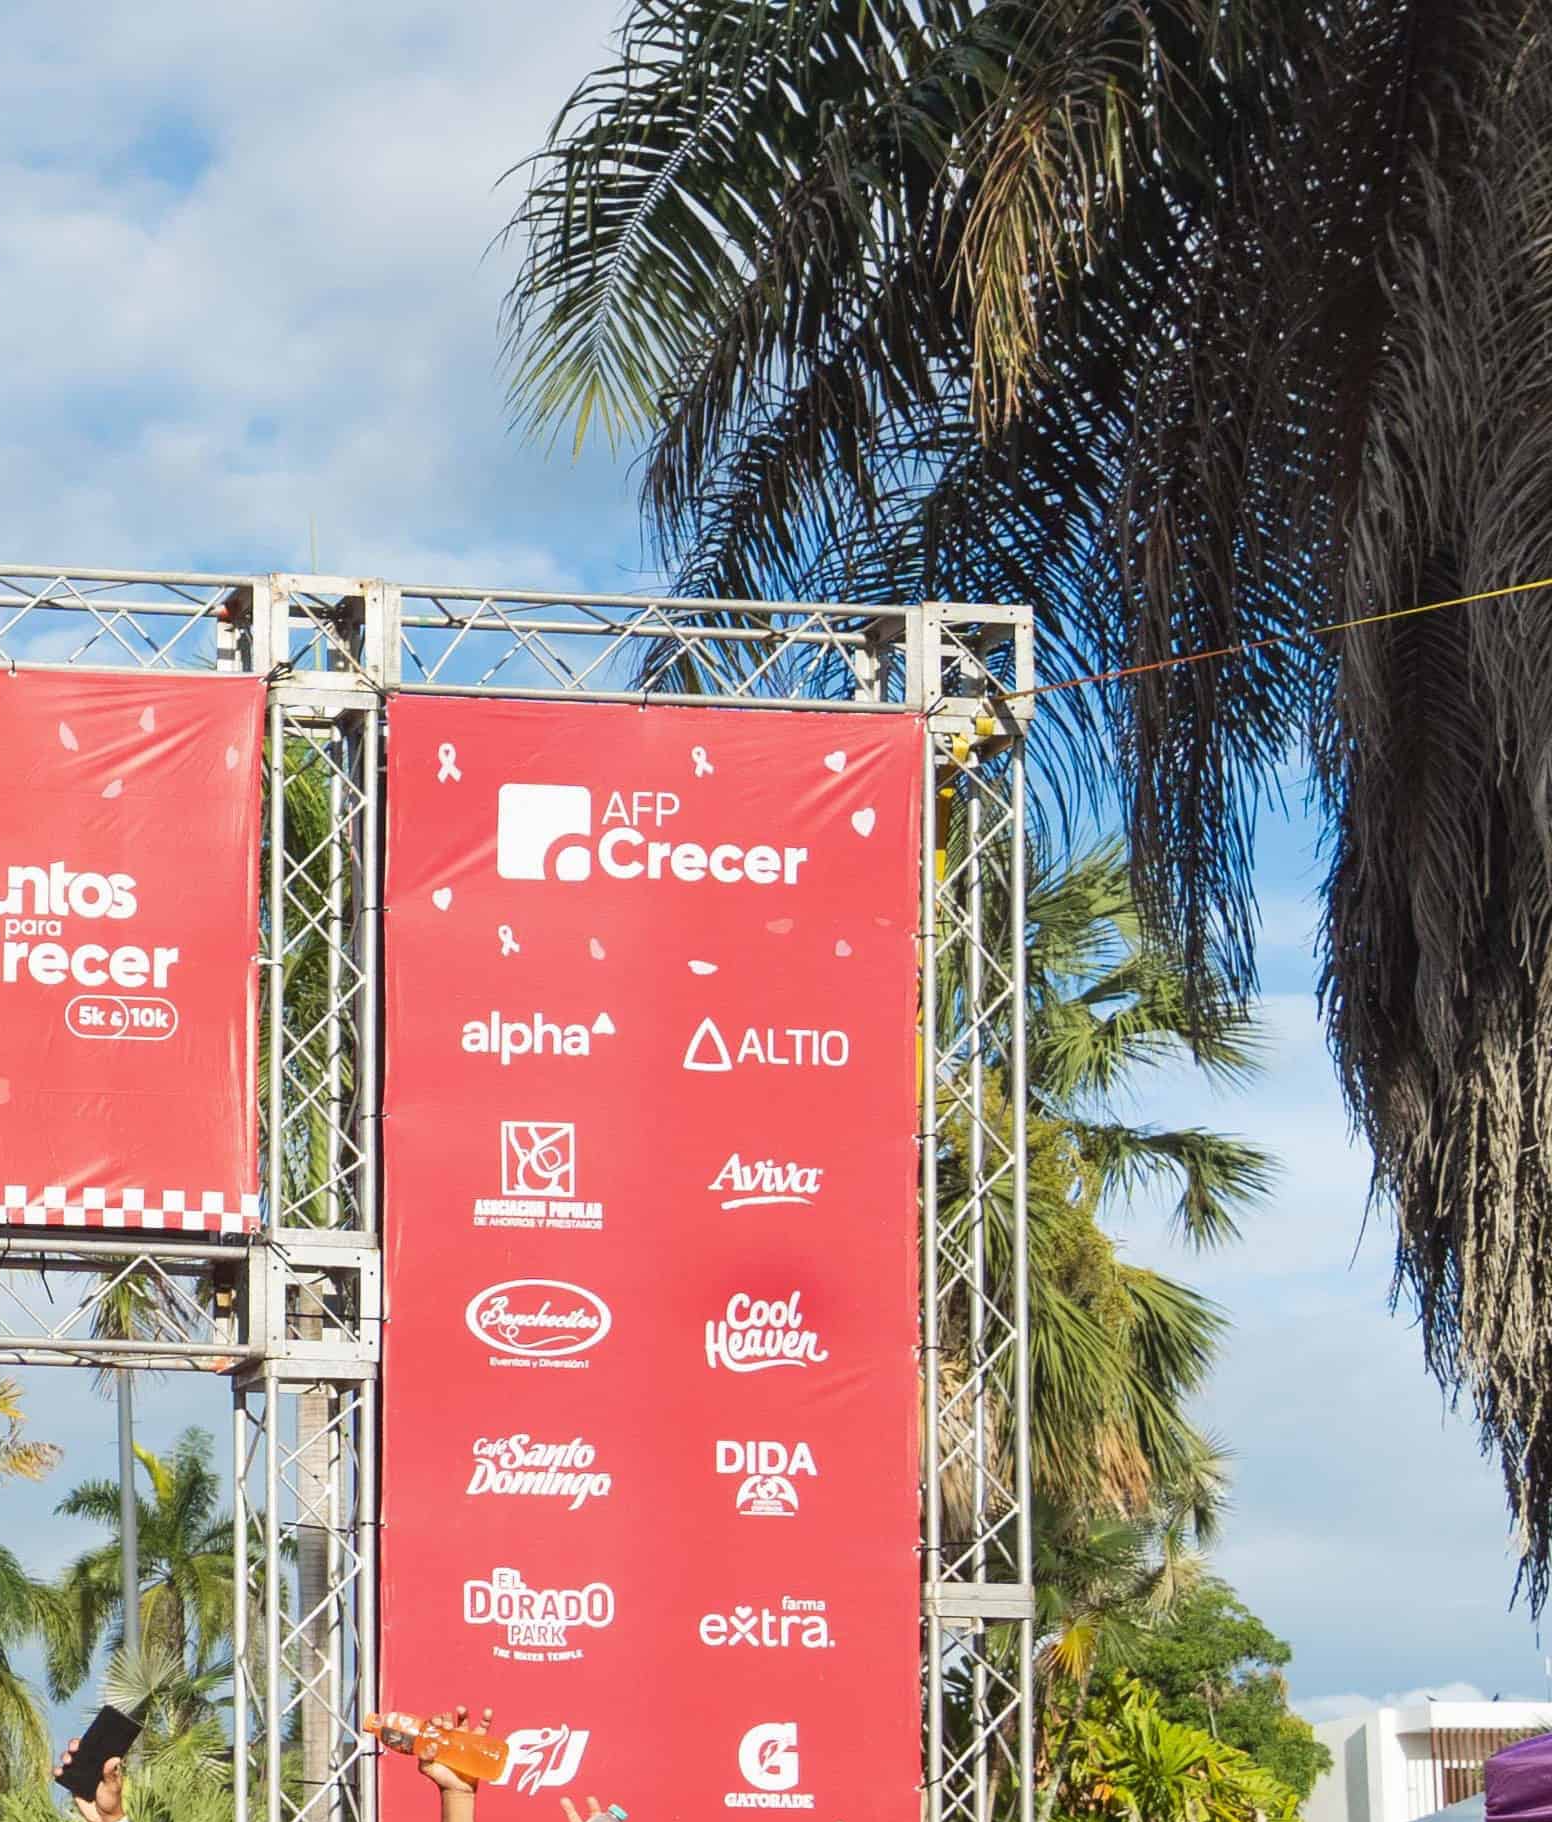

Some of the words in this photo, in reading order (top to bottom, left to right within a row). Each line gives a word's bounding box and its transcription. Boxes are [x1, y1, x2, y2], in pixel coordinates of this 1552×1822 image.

[602, 792, 679, 826] AFP
[598, 828, 808, 884] Crecer
[5, 918, 61, 938] para
[79, 1006, 105, 1026] 5k
[131, 1007, 168, 1029] 10k
[461, 1010, 590, 1064] alpha
[737, 1029, 848, 1067] ALTIO
[708, 1153, 818, 1193] Aviva
[727, 1291, 802, 1330] Cool
[705, 1320, 829, 1369] Heaven
[499, 1434, 595, 1471] Santo
[716, 1440, 817, 1476] DIDA
[466, 1458, 612, 1511] Domingo
[498, 1573, 520, 1590] EL
[470, 1585, 610, 1624] DORADO
[782, 1596, 826, 1612] farma
[510, 1624, 563, 1645] PARK
[724, 1792, 814, 1809] GATORADE
